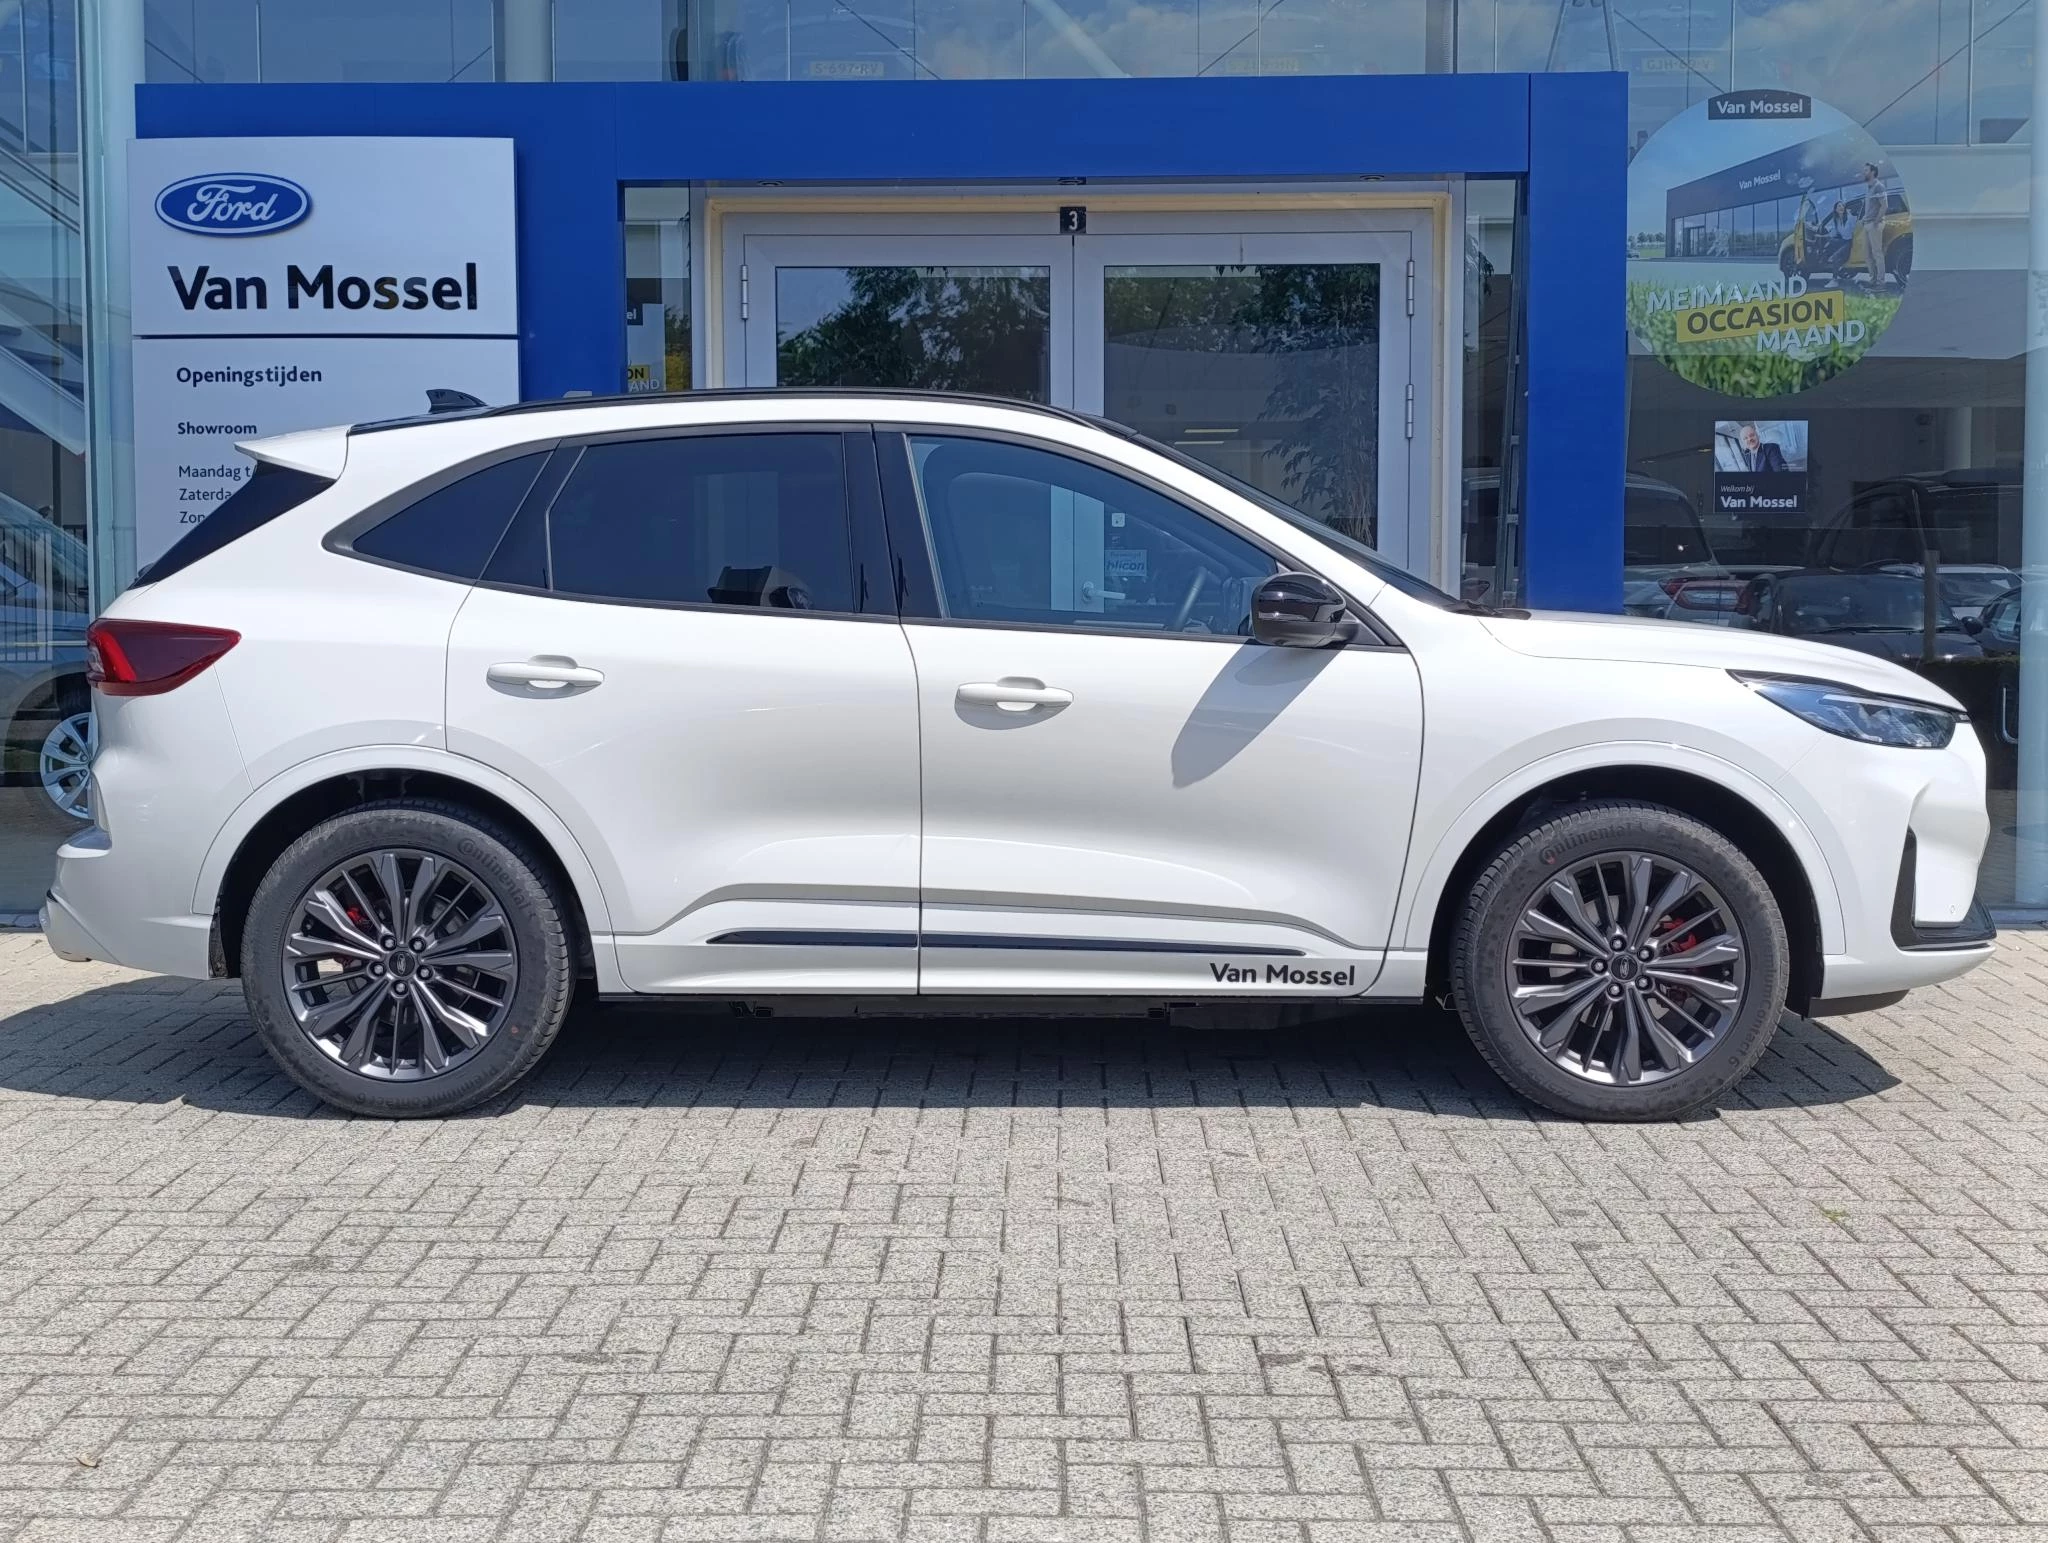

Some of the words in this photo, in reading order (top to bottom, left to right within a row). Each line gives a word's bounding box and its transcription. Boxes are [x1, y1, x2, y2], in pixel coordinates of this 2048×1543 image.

[1717, 101, 1745, 114] Van
[1750, 99, 1803, 113] Mossel
[1739, 180, 1752, 191] Van
[1753, 169, 1781, 187] Mossel
[187, 183, 279, 222] Ford
[1069, 210, 1078, 230] 3
[167, 265, 267, 310] Van
[287, 262, 478, 310] Mossel
[1649, 274, 1807, 314] MEIMAAND
[1687, 297, 1833, 335] OCCASION
[1757, 319, 1865, 353] MAAND
[176, 366, 322, 388] Openingstijden
[177, 421, 257, 435] Showroom
[178, 465, 242, 481] Maandag
[1720, 485, 1745, 493] Welkom
[1746, 484, 1755, 494] bij
[1720, 495, 1746, 508] Van
[1750, 494, 1798, 508] Mossel
[1210, 962, 1257, 984] Van
[1266, 964, 1355, 986] Mossel
